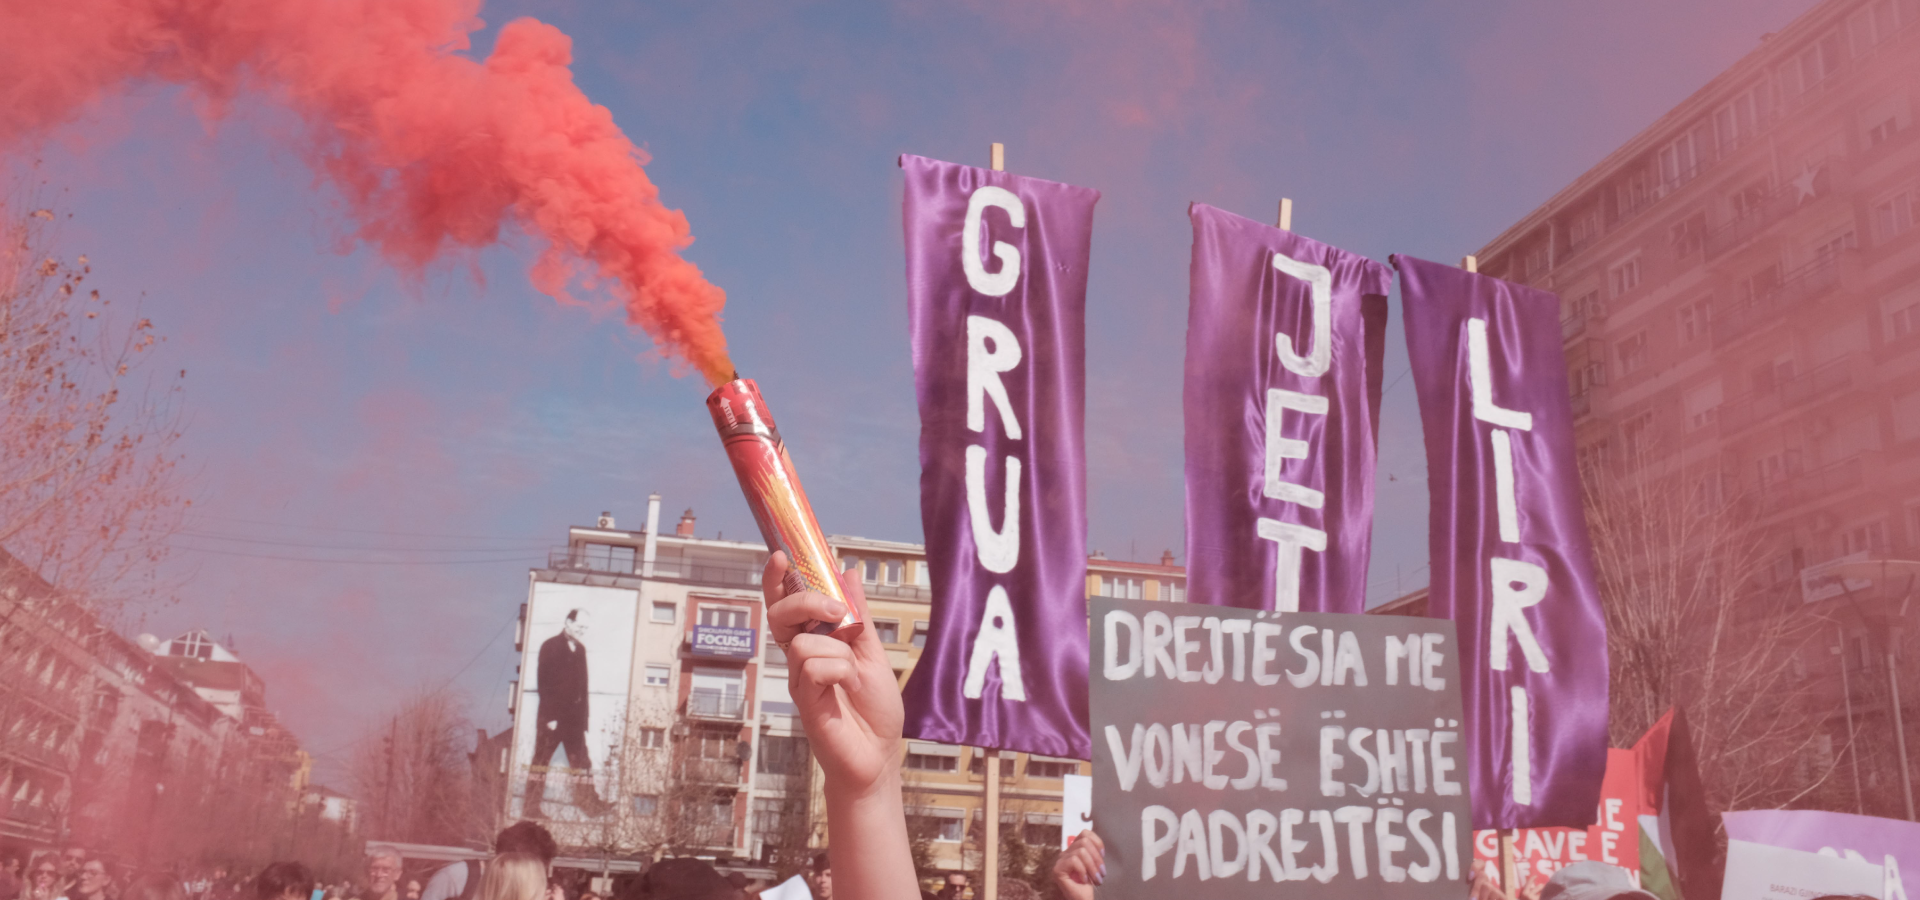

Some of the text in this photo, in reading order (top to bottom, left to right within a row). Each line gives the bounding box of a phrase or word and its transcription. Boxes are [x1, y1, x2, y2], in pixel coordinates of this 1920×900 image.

[962, 186, 1025, 701] GRUA
[1468, 317, 1550, 805] LIRI
[1103, 610, 1446, 691] DREJTËSIA ME
[1104, 708, 1462, 797] VONESË ËSHTË
[1141, 798, 1460, 884] PADREJTËSI
